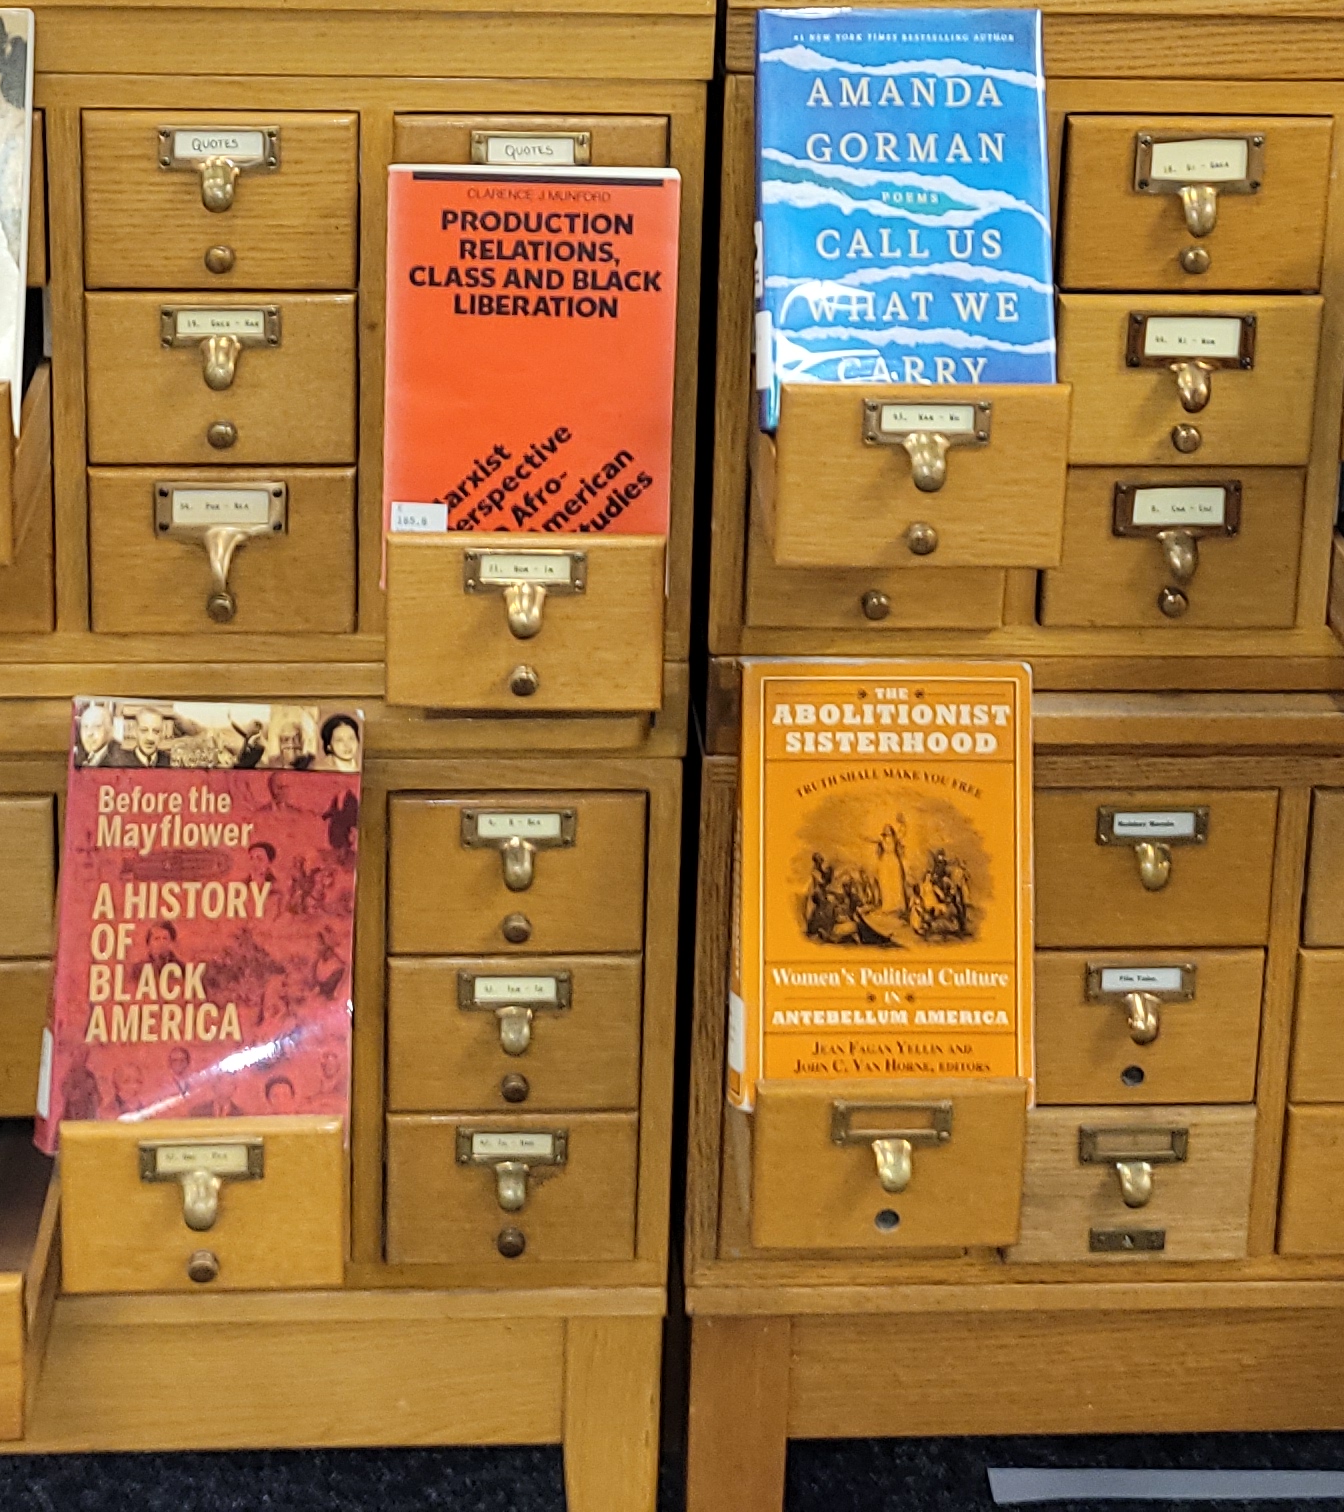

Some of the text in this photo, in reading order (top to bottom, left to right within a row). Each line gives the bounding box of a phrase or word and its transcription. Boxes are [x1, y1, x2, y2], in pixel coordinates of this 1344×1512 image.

[868, 34, 897, 42] TIMES
[973, 34, 1014, 42] AUTHOR
[806, 78, 1003, 107] AMANDA
[191, 136, 240, 152] QUOTES
[505, 143, 555, 158] QUOTES
[806, 133, 1005, 163] GORMAN
[467, 188, 530, 200] CLARENCE
[881, 191, 939, 204] POEMS
[441, 210, 634, 236] PRODUCTION
[458, 239, 621, 267] RELATIONS,
[815, 229, 1003, 259] CALL US
[409, 265, 662, 293] CLASS AND BLACK
[453, 296, 618, 318] LIBERATION
[808, 292, 1019, 323] WHAT WE
[526, 449, 634, 532] merican
[569, 470, 653, 533] tudies
[875, 687, 909, 700] THE
[772, 703, 1011, 726] ABOLITIONIST
[785, 731, 998, 754] SISTERHOOD
[796, 768, 982, 799] TRUTH SHALL MAKE YOU FREE
[98, 785, 232, 815] Before the
[96, 814, 255, 856] Mayflower
[92, 882, 272, 920] A HISTORY
[90, 923, 136, 961] OF
[88, 962, 206, 1002] BLACK
[772, 966, 1009, 987] Women's Political Culture
[884, 992, 902, 1004] IN
[84, 1003, 242, 1043] AMERICA
[772, 1010, 1009, 1026] ANTEBELLUM AMERICA
[812, 1041, 973, 1055] JEAN FAGAN YELLIN AND
[794, 1059, 829, 1074] JOHN
[853, 1059, 881, 1073] VAN
[939, 1061, 992, 1073] EDITORS
